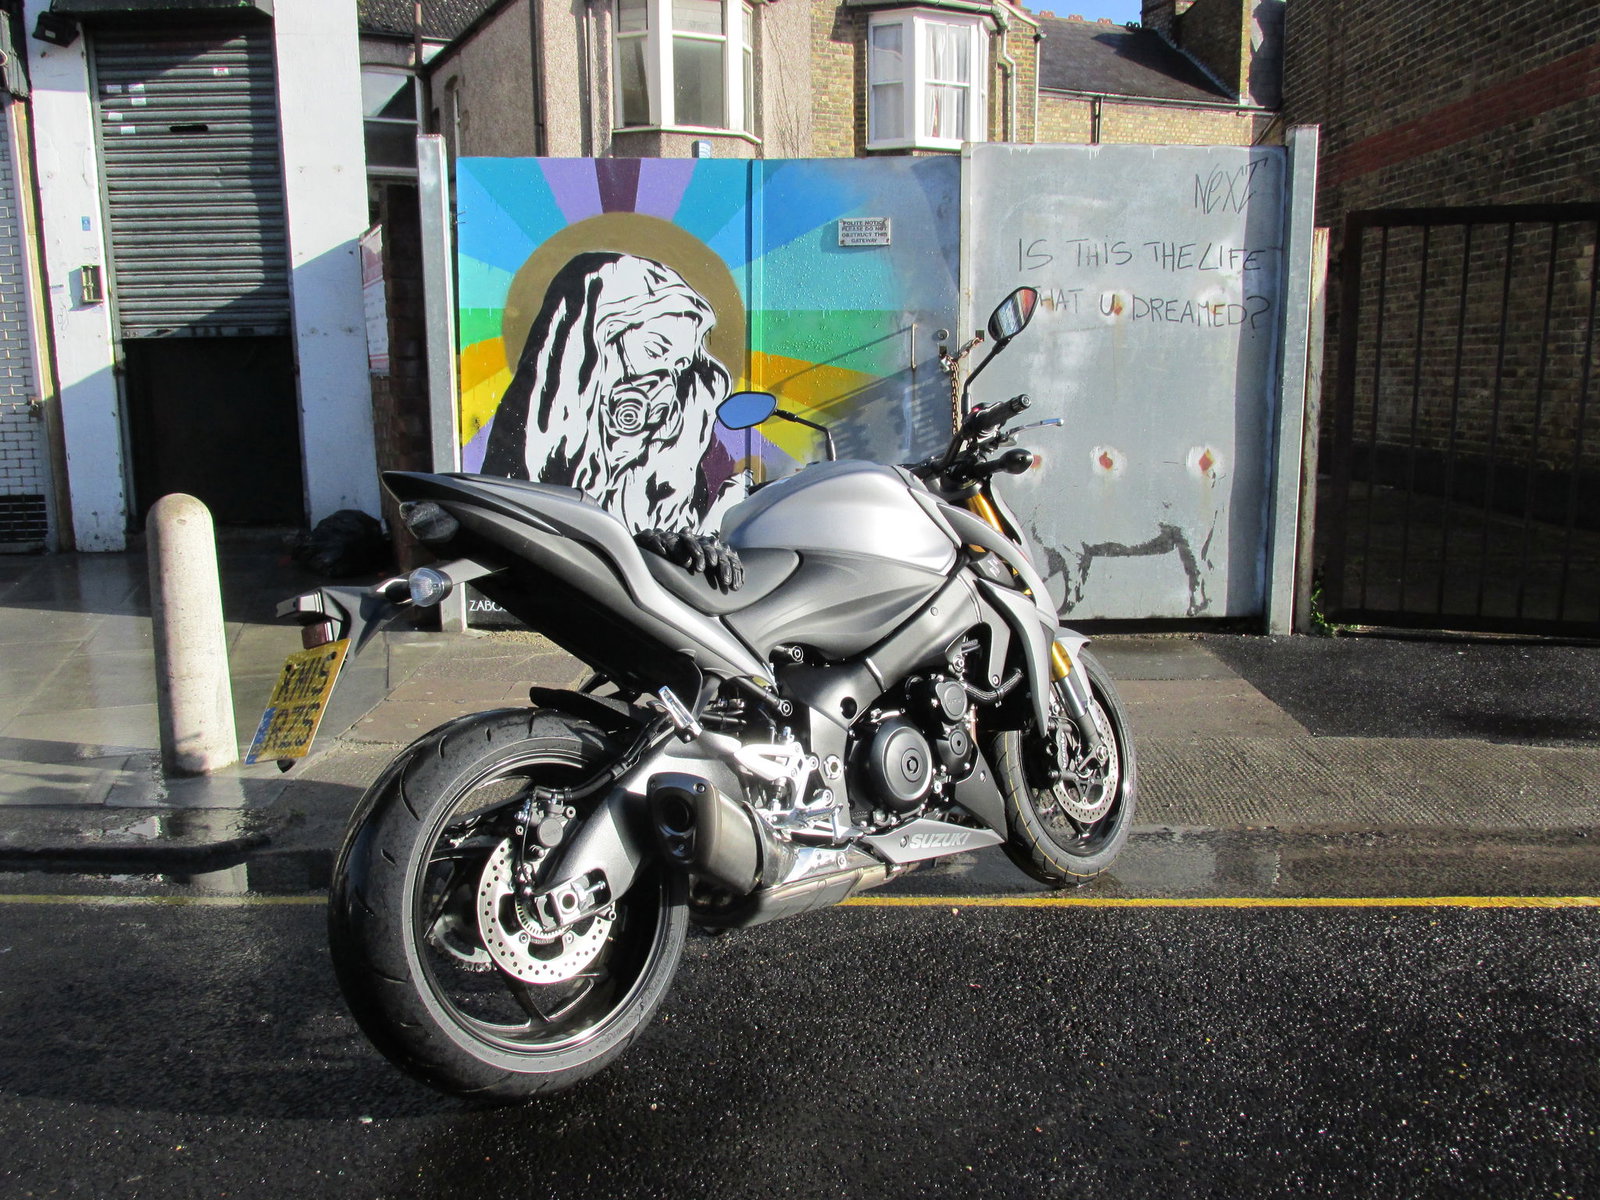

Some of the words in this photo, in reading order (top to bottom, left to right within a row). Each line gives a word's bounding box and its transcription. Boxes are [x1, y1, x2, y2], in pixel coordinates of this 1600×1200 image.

[1018, 238, 1053, 272] IS
[1143, 241, 1196, 272] THE
[1198, 243, 1265, 270] LIFE
[1032, 285, 1083, 314] HAT
[1100, 293, 1116, 316] U
[1132, 295, 1270, 339] DREAMED?
[909, 832, 971, 849] SUZUKI
